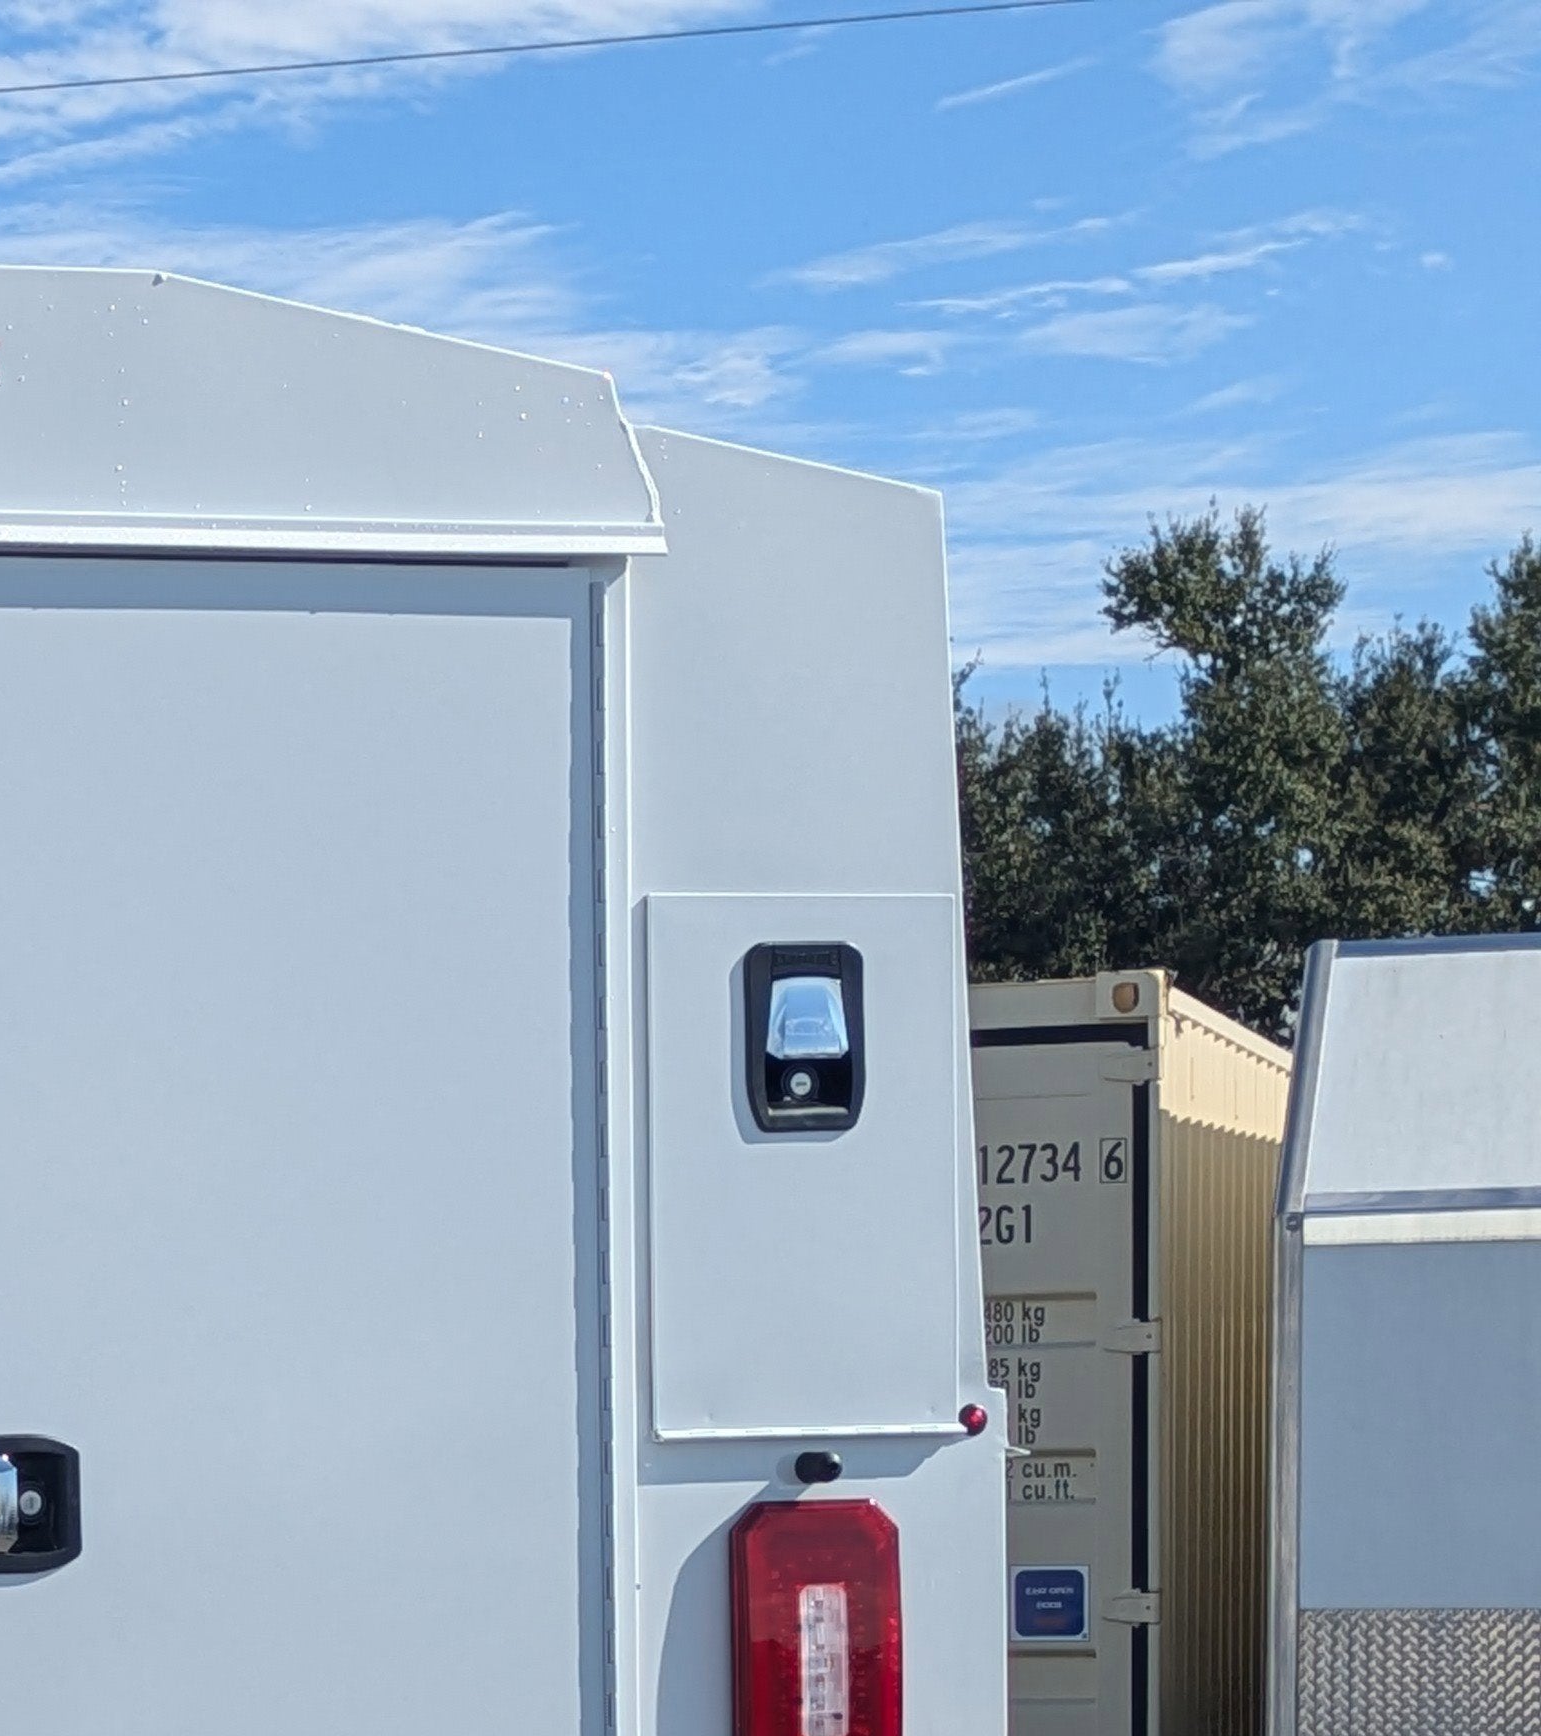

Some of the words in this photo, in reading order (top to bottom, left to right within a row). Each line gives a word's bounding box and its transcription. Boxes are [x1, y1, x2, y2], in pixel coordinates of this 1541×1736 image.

[979, 1141, 1081, 1185] 12734
[1104, 1141, 1124, 1180] 6
[1022, 1301, 1045, 1326] kg
[1022, 1323, 1040, 1343] lb
[1018, 1357, 1041, 1382] kg
[1018, 1379, 1036, 1398] lb
[1018, 1403, 1041, 1428] kg
[1018, 1425, 1036, 1444] lb
[1022, 1463, 1077, 1478] cu.m.
[1022, 1479, 1075, 1500] cu.ft.
